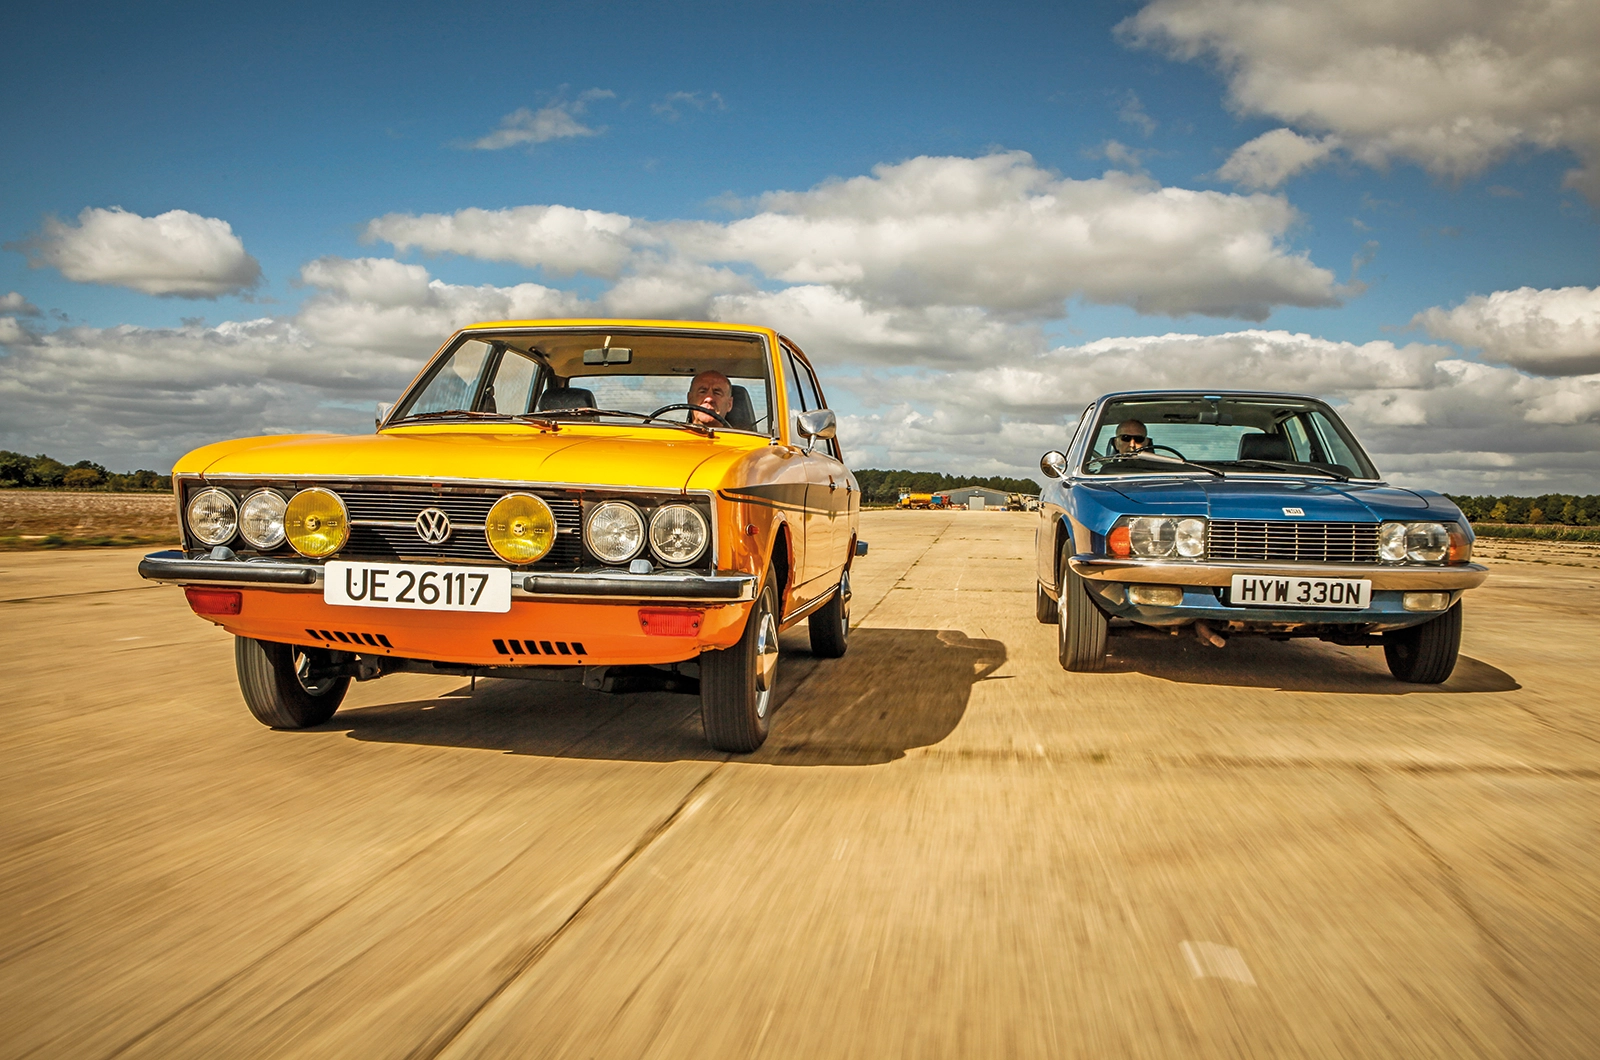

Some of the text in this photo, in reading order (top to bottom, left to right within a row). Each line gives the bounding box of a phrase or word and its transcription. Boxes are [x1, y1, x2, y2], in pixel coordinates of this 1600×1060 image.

[417, 508, 450, 543] VW
[346, 568, 489, 606] UE 26117
[1242, 579, 1361, 605] HYW 330N
